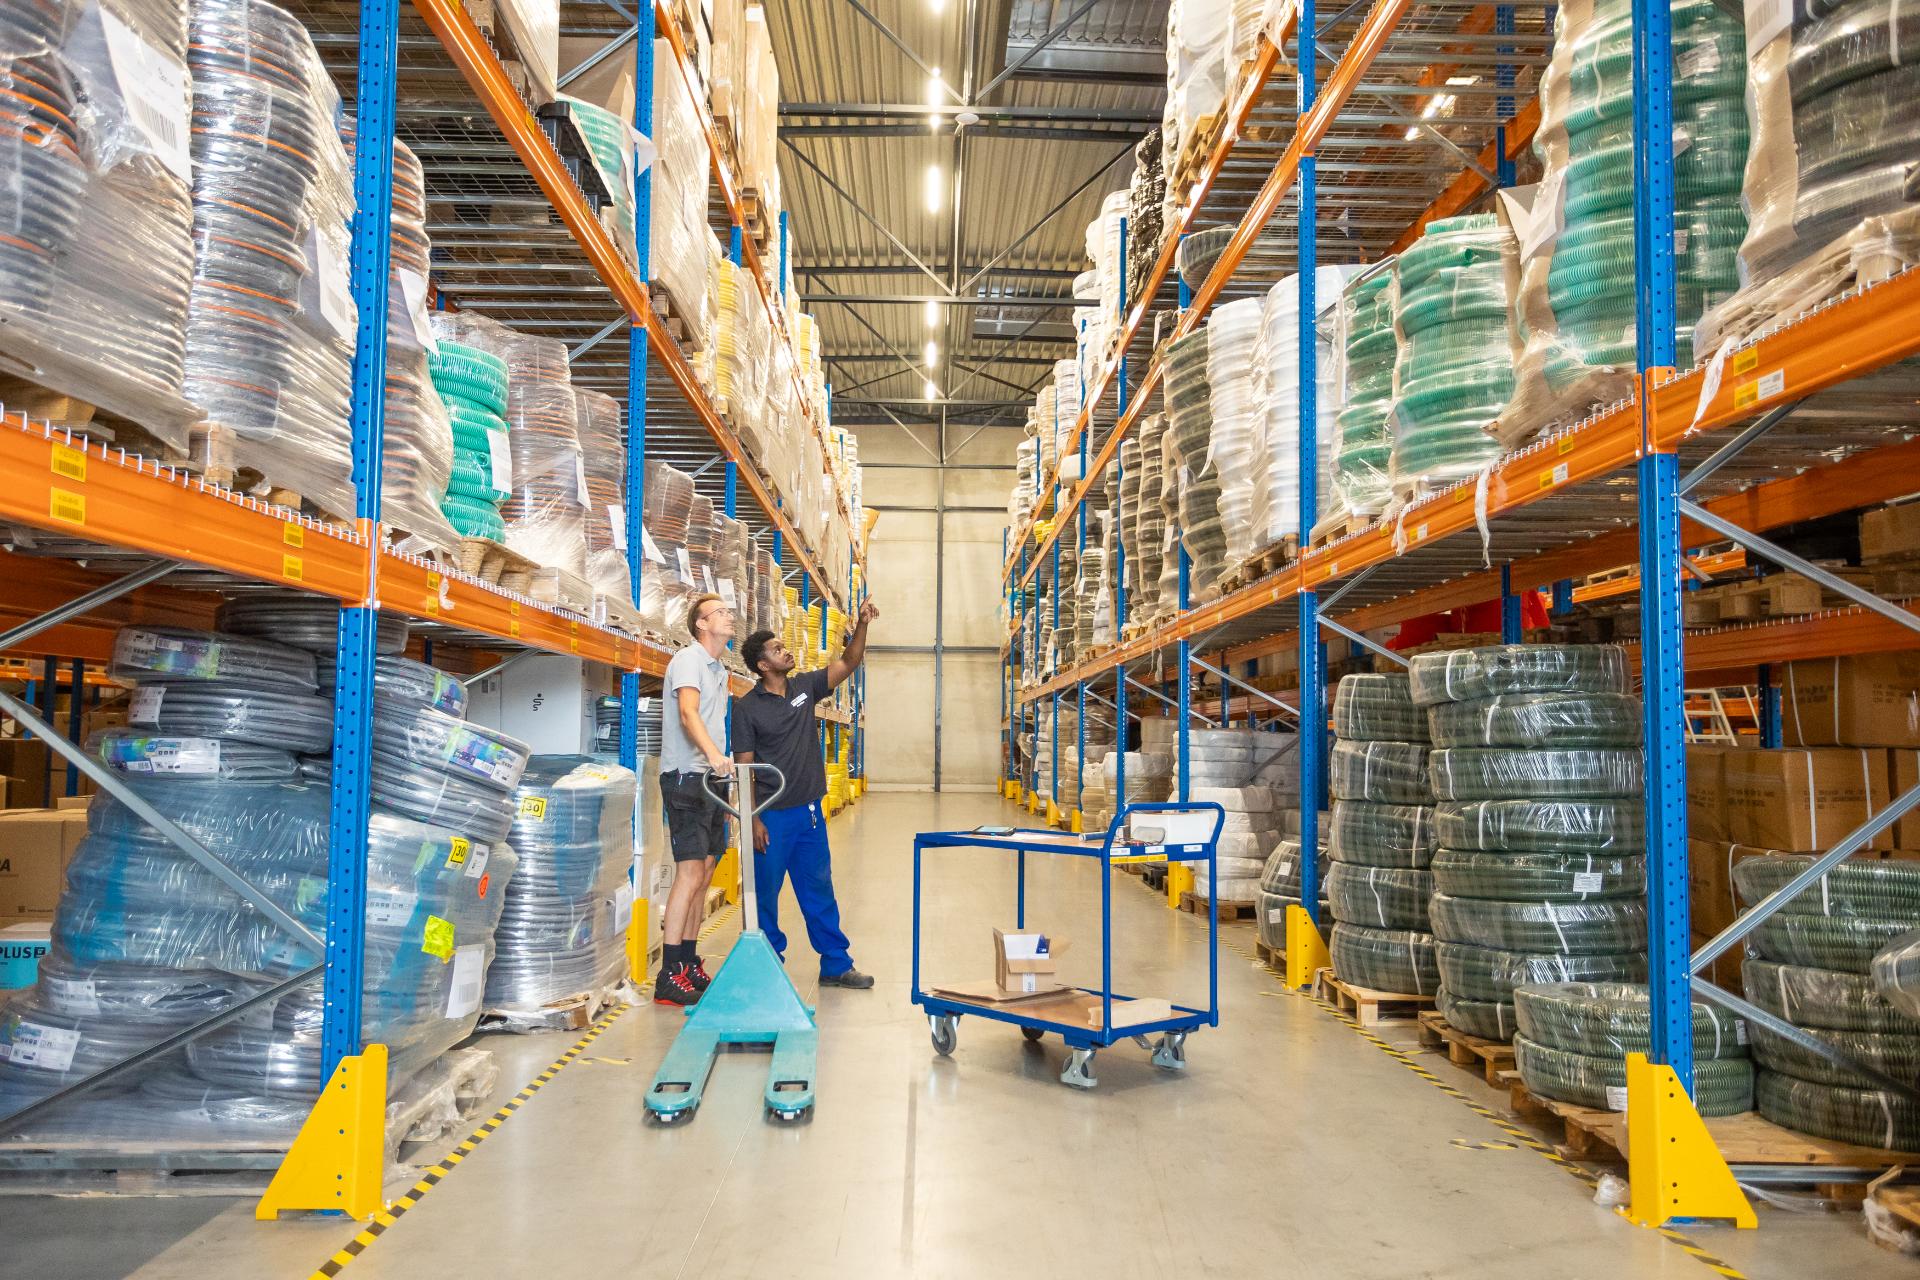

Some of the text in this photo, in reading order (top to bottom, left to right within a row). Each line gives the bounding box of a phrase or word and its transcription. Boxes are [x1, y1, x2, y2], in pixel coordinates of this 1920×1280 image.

[525, 802, 540, 813] 30
[456, 845, 467, 857] 30
[0, 858, 11, 872] A
